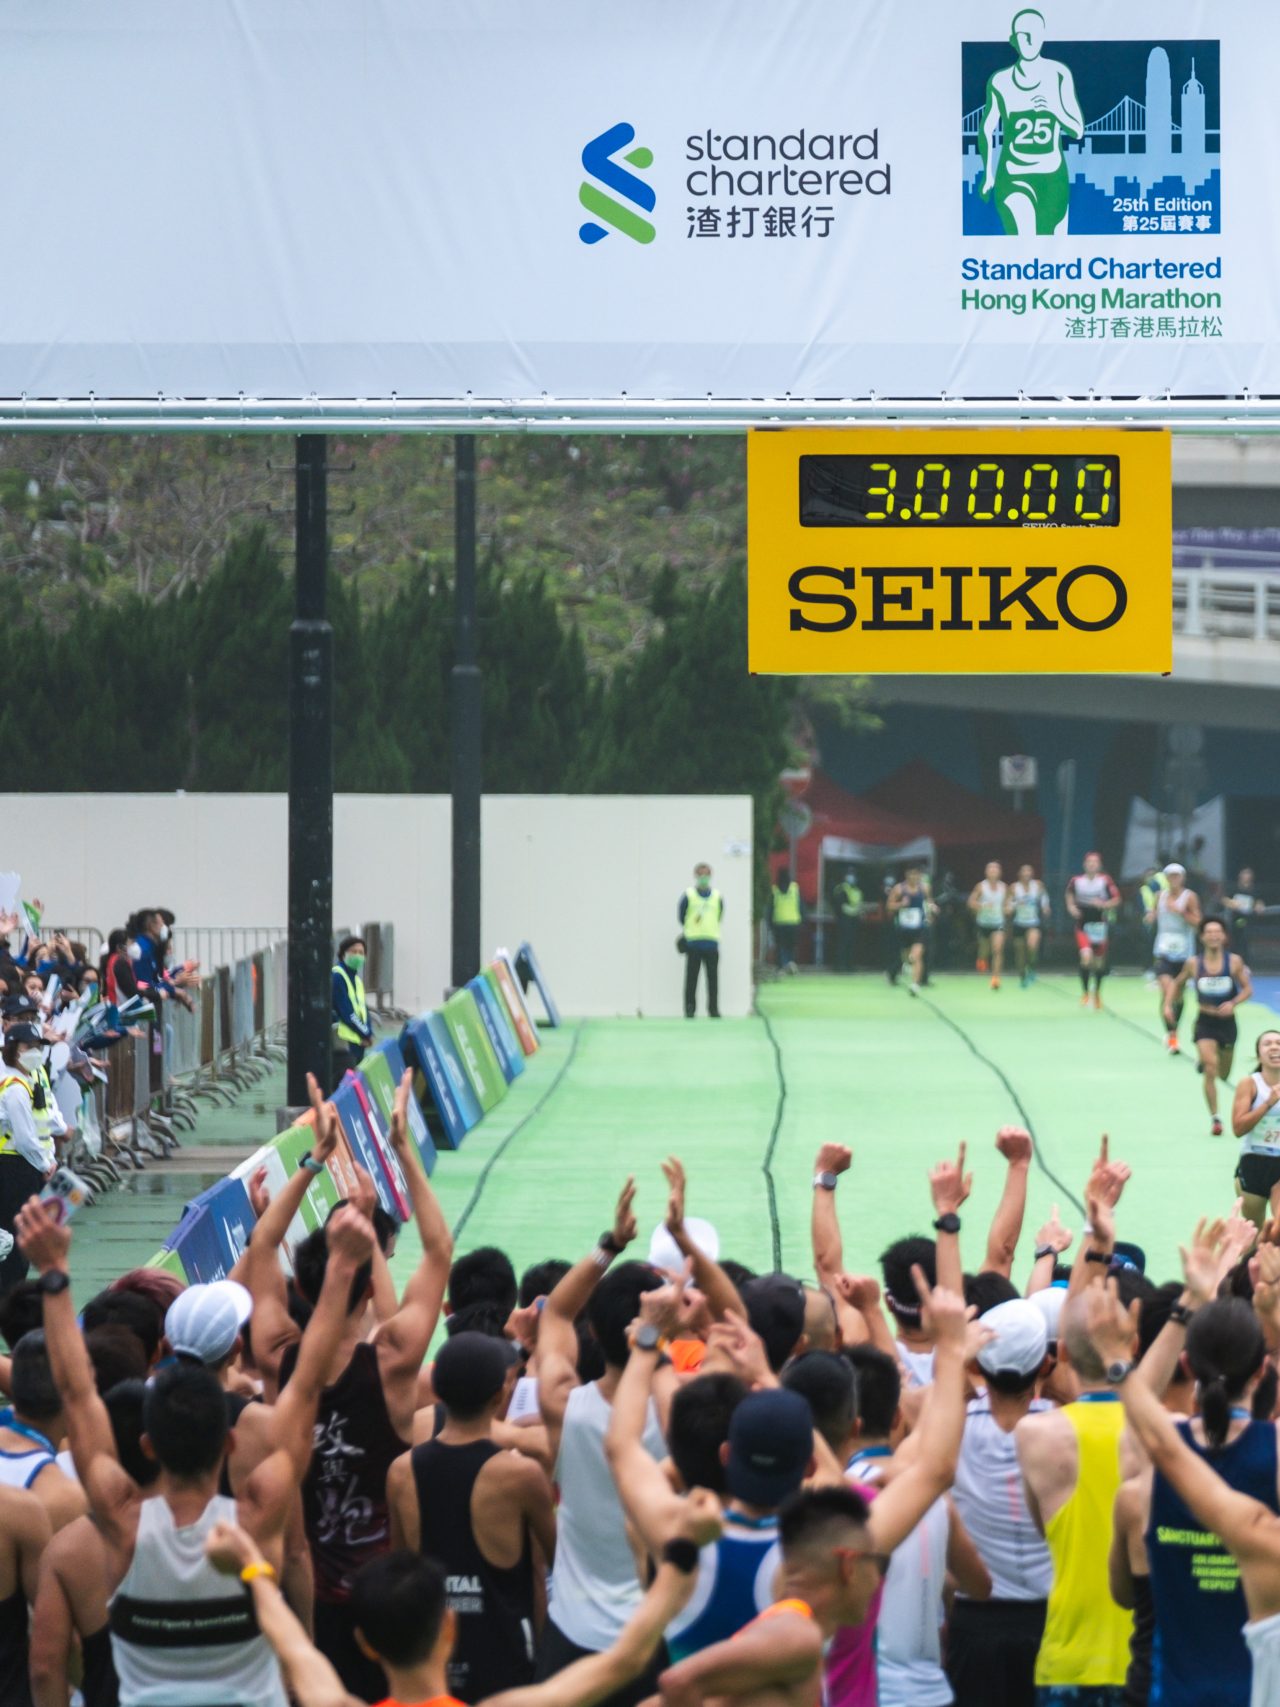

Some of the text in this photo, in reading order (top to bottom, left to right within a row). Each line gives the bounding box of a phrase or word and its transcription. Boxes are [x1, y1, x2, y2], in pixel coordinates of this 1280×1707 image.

[686, 128, 878, 161] standard
[1015, 117, 1052, 145] 25
[687, 164, 890, 196] chartered
[1112, 196, 1212, 213] 25th Edition
[687, 206, 834, 238] 渣打銀行
[1121, 215, 1212, 232] 第25屆賽事
[962, 257, 1221, 280] Standard Chartered
[962, 288, 1221, 315] Hong Kong Marathon
[1065, 316, 1222, 338] 渣打香港馬拉松
[788, 565, 1127, 632] SEIKO
